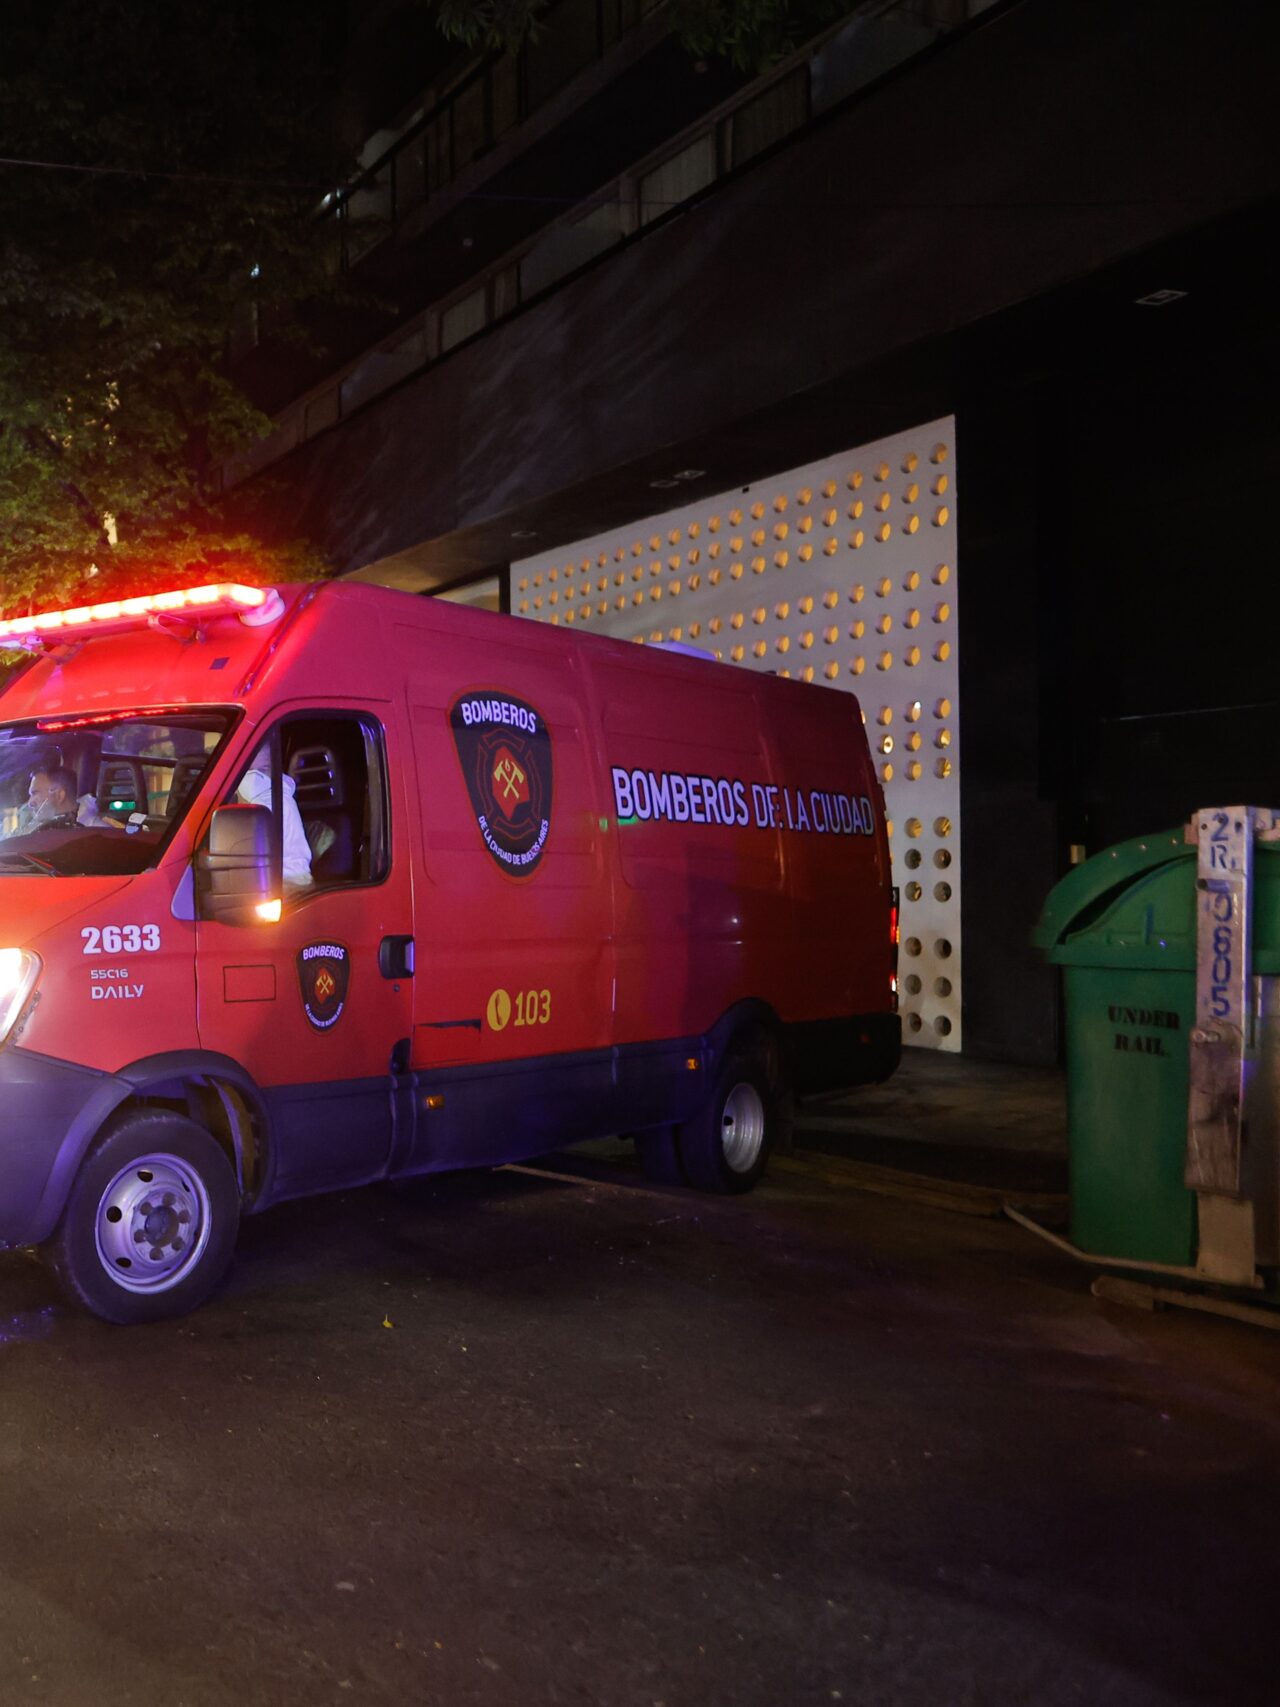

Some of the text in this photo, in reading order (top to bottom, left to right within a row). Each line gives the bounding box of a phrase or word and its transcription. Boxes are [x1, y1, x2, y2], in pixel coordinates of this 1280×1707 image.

[461, 700, 537, 734] BOMBEROS
[611, 767, 875, 836] BOMBEROS DE LA CIUDAD
[478, 815, 488, 831] DE
[483, 828, 493, 845] LA
[489, 839, 513, 864] CIUDAD
[512, 854, 521, 865] DE
[538, 818, 549, 847] AIRES
[80, 924, 161, 955] 2633
[303, 945, 346, 961] BOMBEROS
[91, 984, 145, 1000] DAILY
[514, 988, 552, 1026] 103
[1108, 1005, 1180, 1030] UNDER
